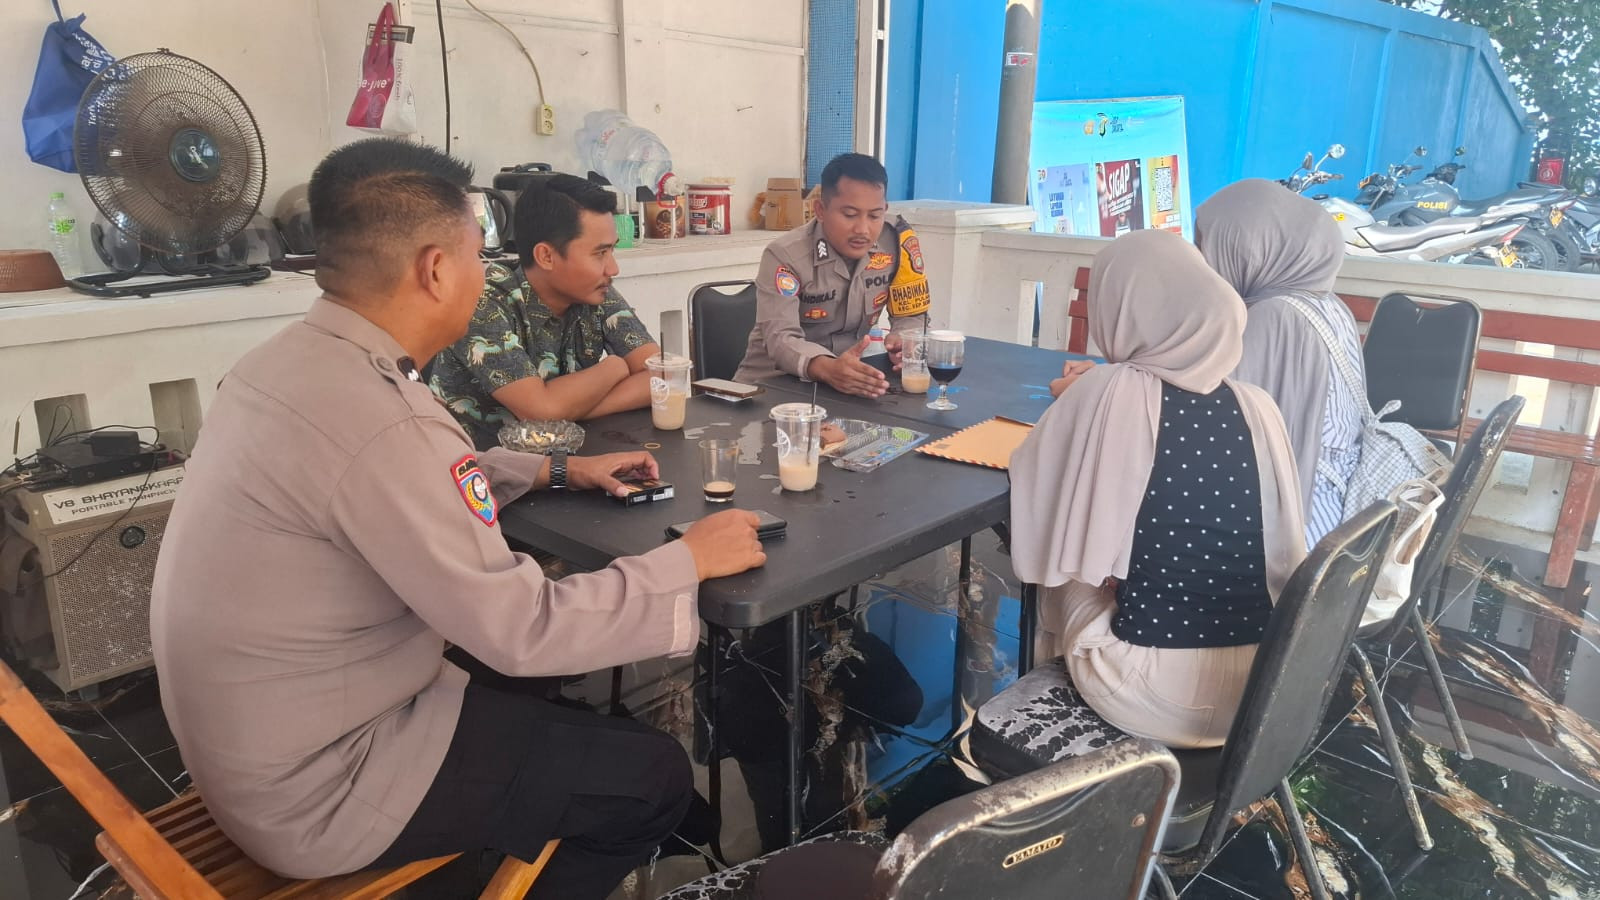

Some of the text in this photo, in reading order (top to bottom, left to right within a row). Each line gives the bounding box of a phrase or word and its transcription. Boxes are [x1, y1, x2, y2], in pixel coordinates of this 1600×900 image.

[1109, 162, 1131, 200] SIGAP
[1417, 201, 1448, 210] POLISI
[54, 499, 76, 509] V8
[72, 498, 126, 515] PORTABLE
